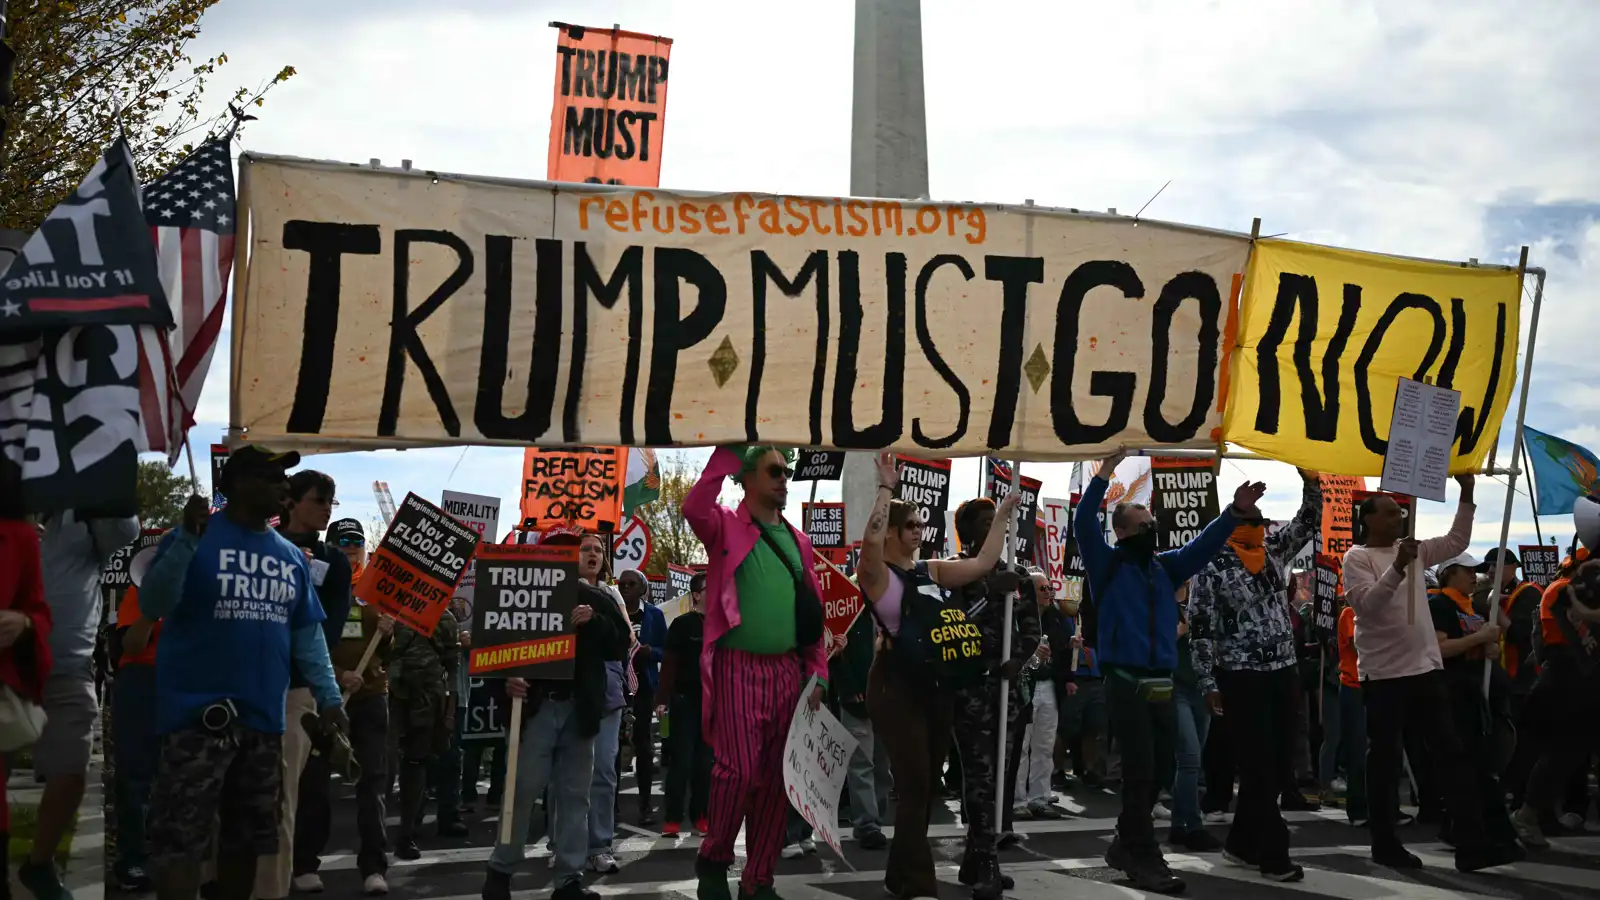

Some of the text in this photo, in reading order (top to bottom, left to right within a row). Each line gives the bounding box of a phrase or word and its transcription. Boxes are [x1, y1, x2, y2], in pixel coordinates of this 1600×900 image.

[557, 45, 669, 104] TRUMP
[564, 106, 657, 161] MUST
[578, 191, 986, 244] refusefascism.org
[282, 219, 727, 446] TRUMP
[745, 249, 1044, 449] MUST
[1050, 260, 1221, 445] GO
[1254, 272, 1506, 456] NOW
[533, 457, 616, 479] REFUSE
[811, 452, 828, 465] GO
[801, 464, 835, 477] NOW!
[899, 463, 947, 489] TRUMP
[1155, 471, 1213, 490] TRUMP
[525, 478, 619, 503] FASCISM
[901, 484, 941, 507] MUST
[1162, 491, 1208, 509] MUST
[407, 497, 440, 521] Beginning
[440, 514, 476, 544] Wednesday,
[444, 500, 499, 520] MORALITY
[829, 508, 842, 520] SE
[1175, 510, 1199, 528] GO
[416, 518, 444, 540] Nov
[444, 535, 457, 549] 5
[810, 521, 842, 533] ARGUE
[393, 522, 442, 557] FLOOD
[441, 550, 465, 570] DC
[1543, 551, 1555, 562] SE
[219, 548, 297, 586] FUCK
[387, 535, 457, 580] with nonviolent protest
[373, 554, 414, 585] TRUMP
[411, 576, 449, 605] MUST
[488, 566, 566, 587] TRUMP
[671, 580, 690, 591] MUS
[1316, 567, 1338, 586] TRUMP
[216, 573, 296, 604] TRUMP
[376, 578, 429, 615] GO NOW!
[499, 589, 552, 609] DOIT
[1317, 583, 1336, 600] MUST
[214, 609, 231, 620] FOR
[215, 599, 240, 610] AND
[243, 600, 272, 612] FUCK
[825, 595, 858, 620] RIGHT
[1321, 600, 1332, 613] GO
[484, 611, 564, 632] PARTIR
[1316, 613, 1334, 631] NOW!
[475, 640, 570, 668] MAINTENANT!
